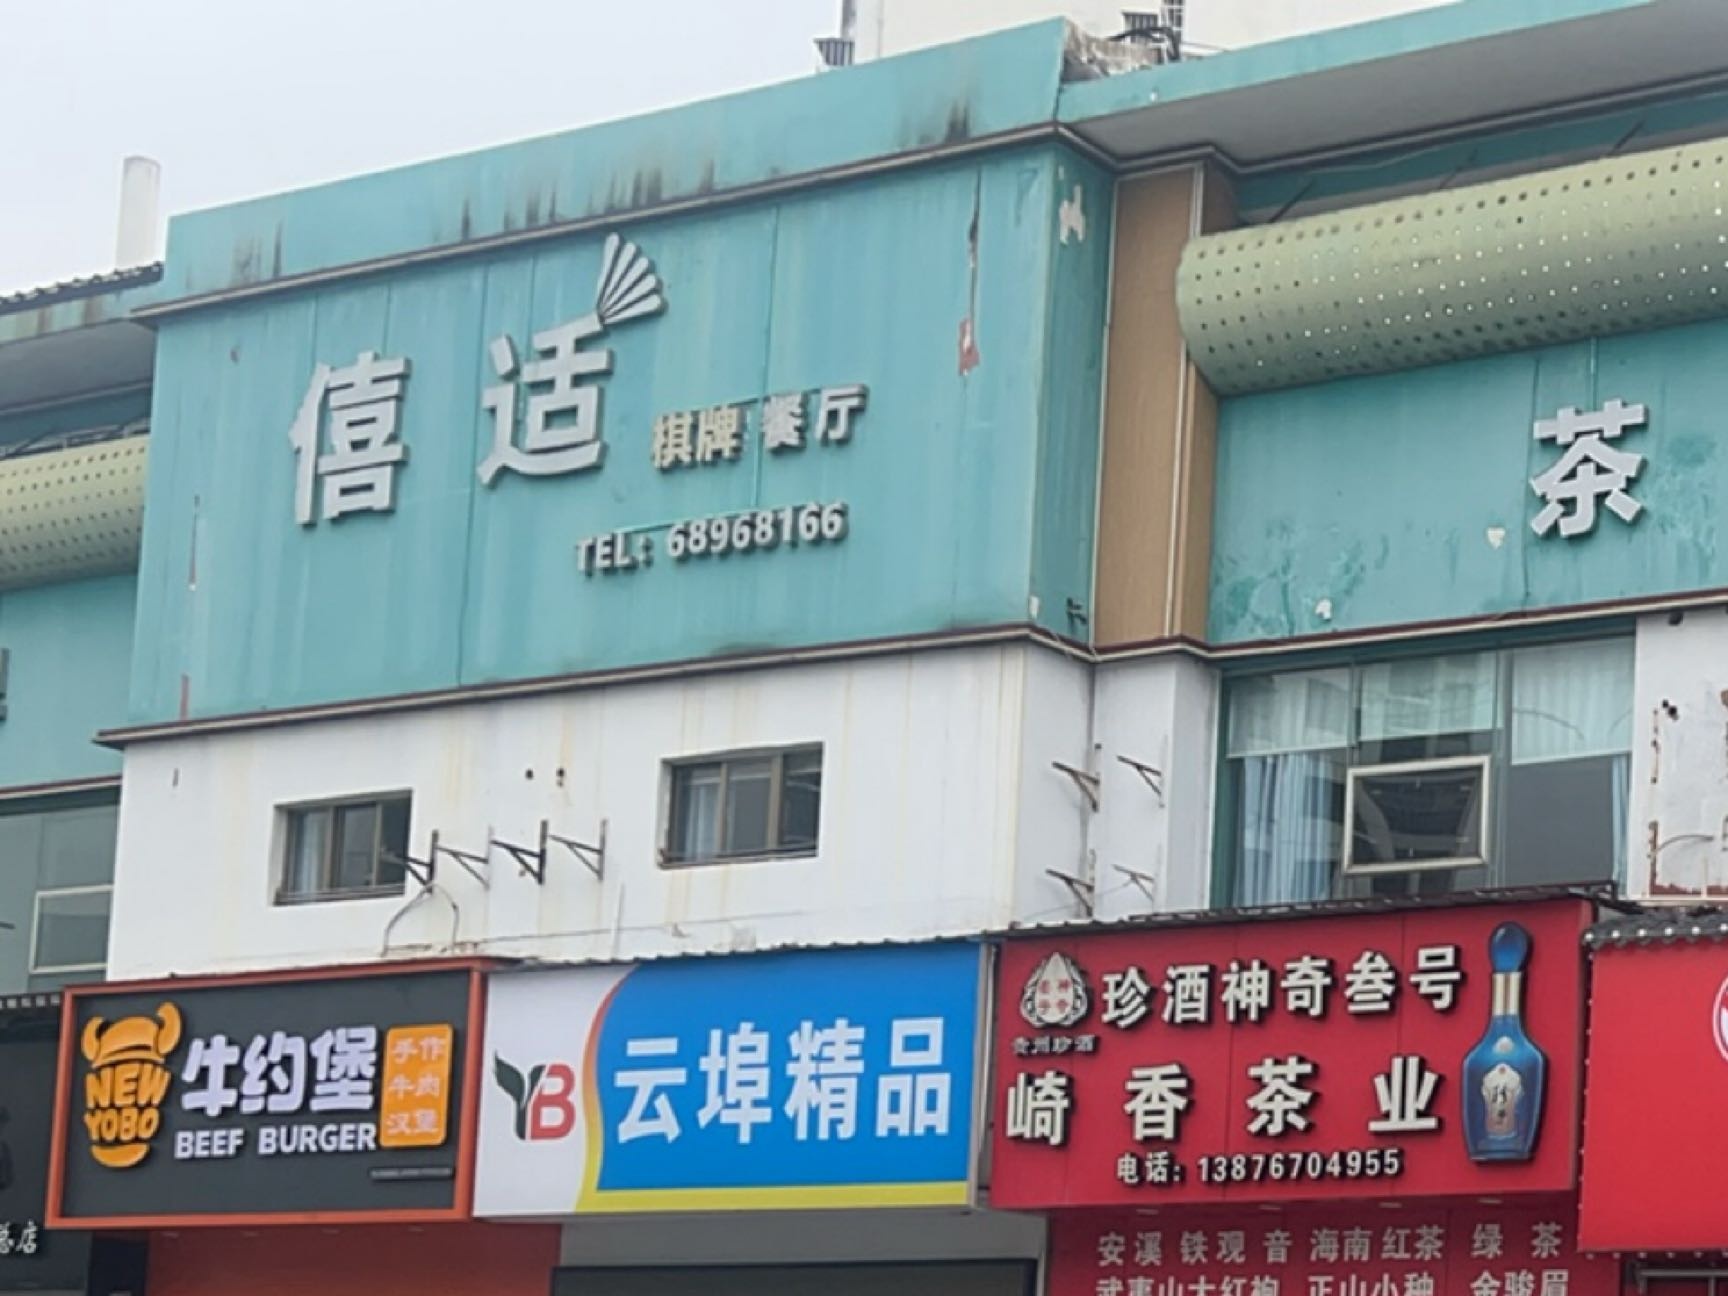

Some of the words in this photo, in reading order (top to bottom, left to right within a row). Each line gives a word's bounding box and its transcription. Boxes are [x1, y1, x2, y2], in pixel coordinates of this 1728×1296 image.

[287, 312, 613, 525] 僖适
[651, 384, 869, 470] 棋牌餐厅
[1102, 944, 1463, 1029] 珍酒神奇叁号
[84, 1062, 171, 1108] NEW
[181, 1026, 378, 1116] 牛约堡
[614, 1016, 951, 1144] 云埠精品
[1006, 1055, 1441, 1147] 崎香茶业
[84, 1108, 159, 1142] YOBO
[174, 1128, 244, 1159] BEEF
[257, 1123, 377, 1154] BURGER
[1311, 1226, 1444, 1262] 海南红茶
[1471, 1223, 1563, 1259] 绿茶
